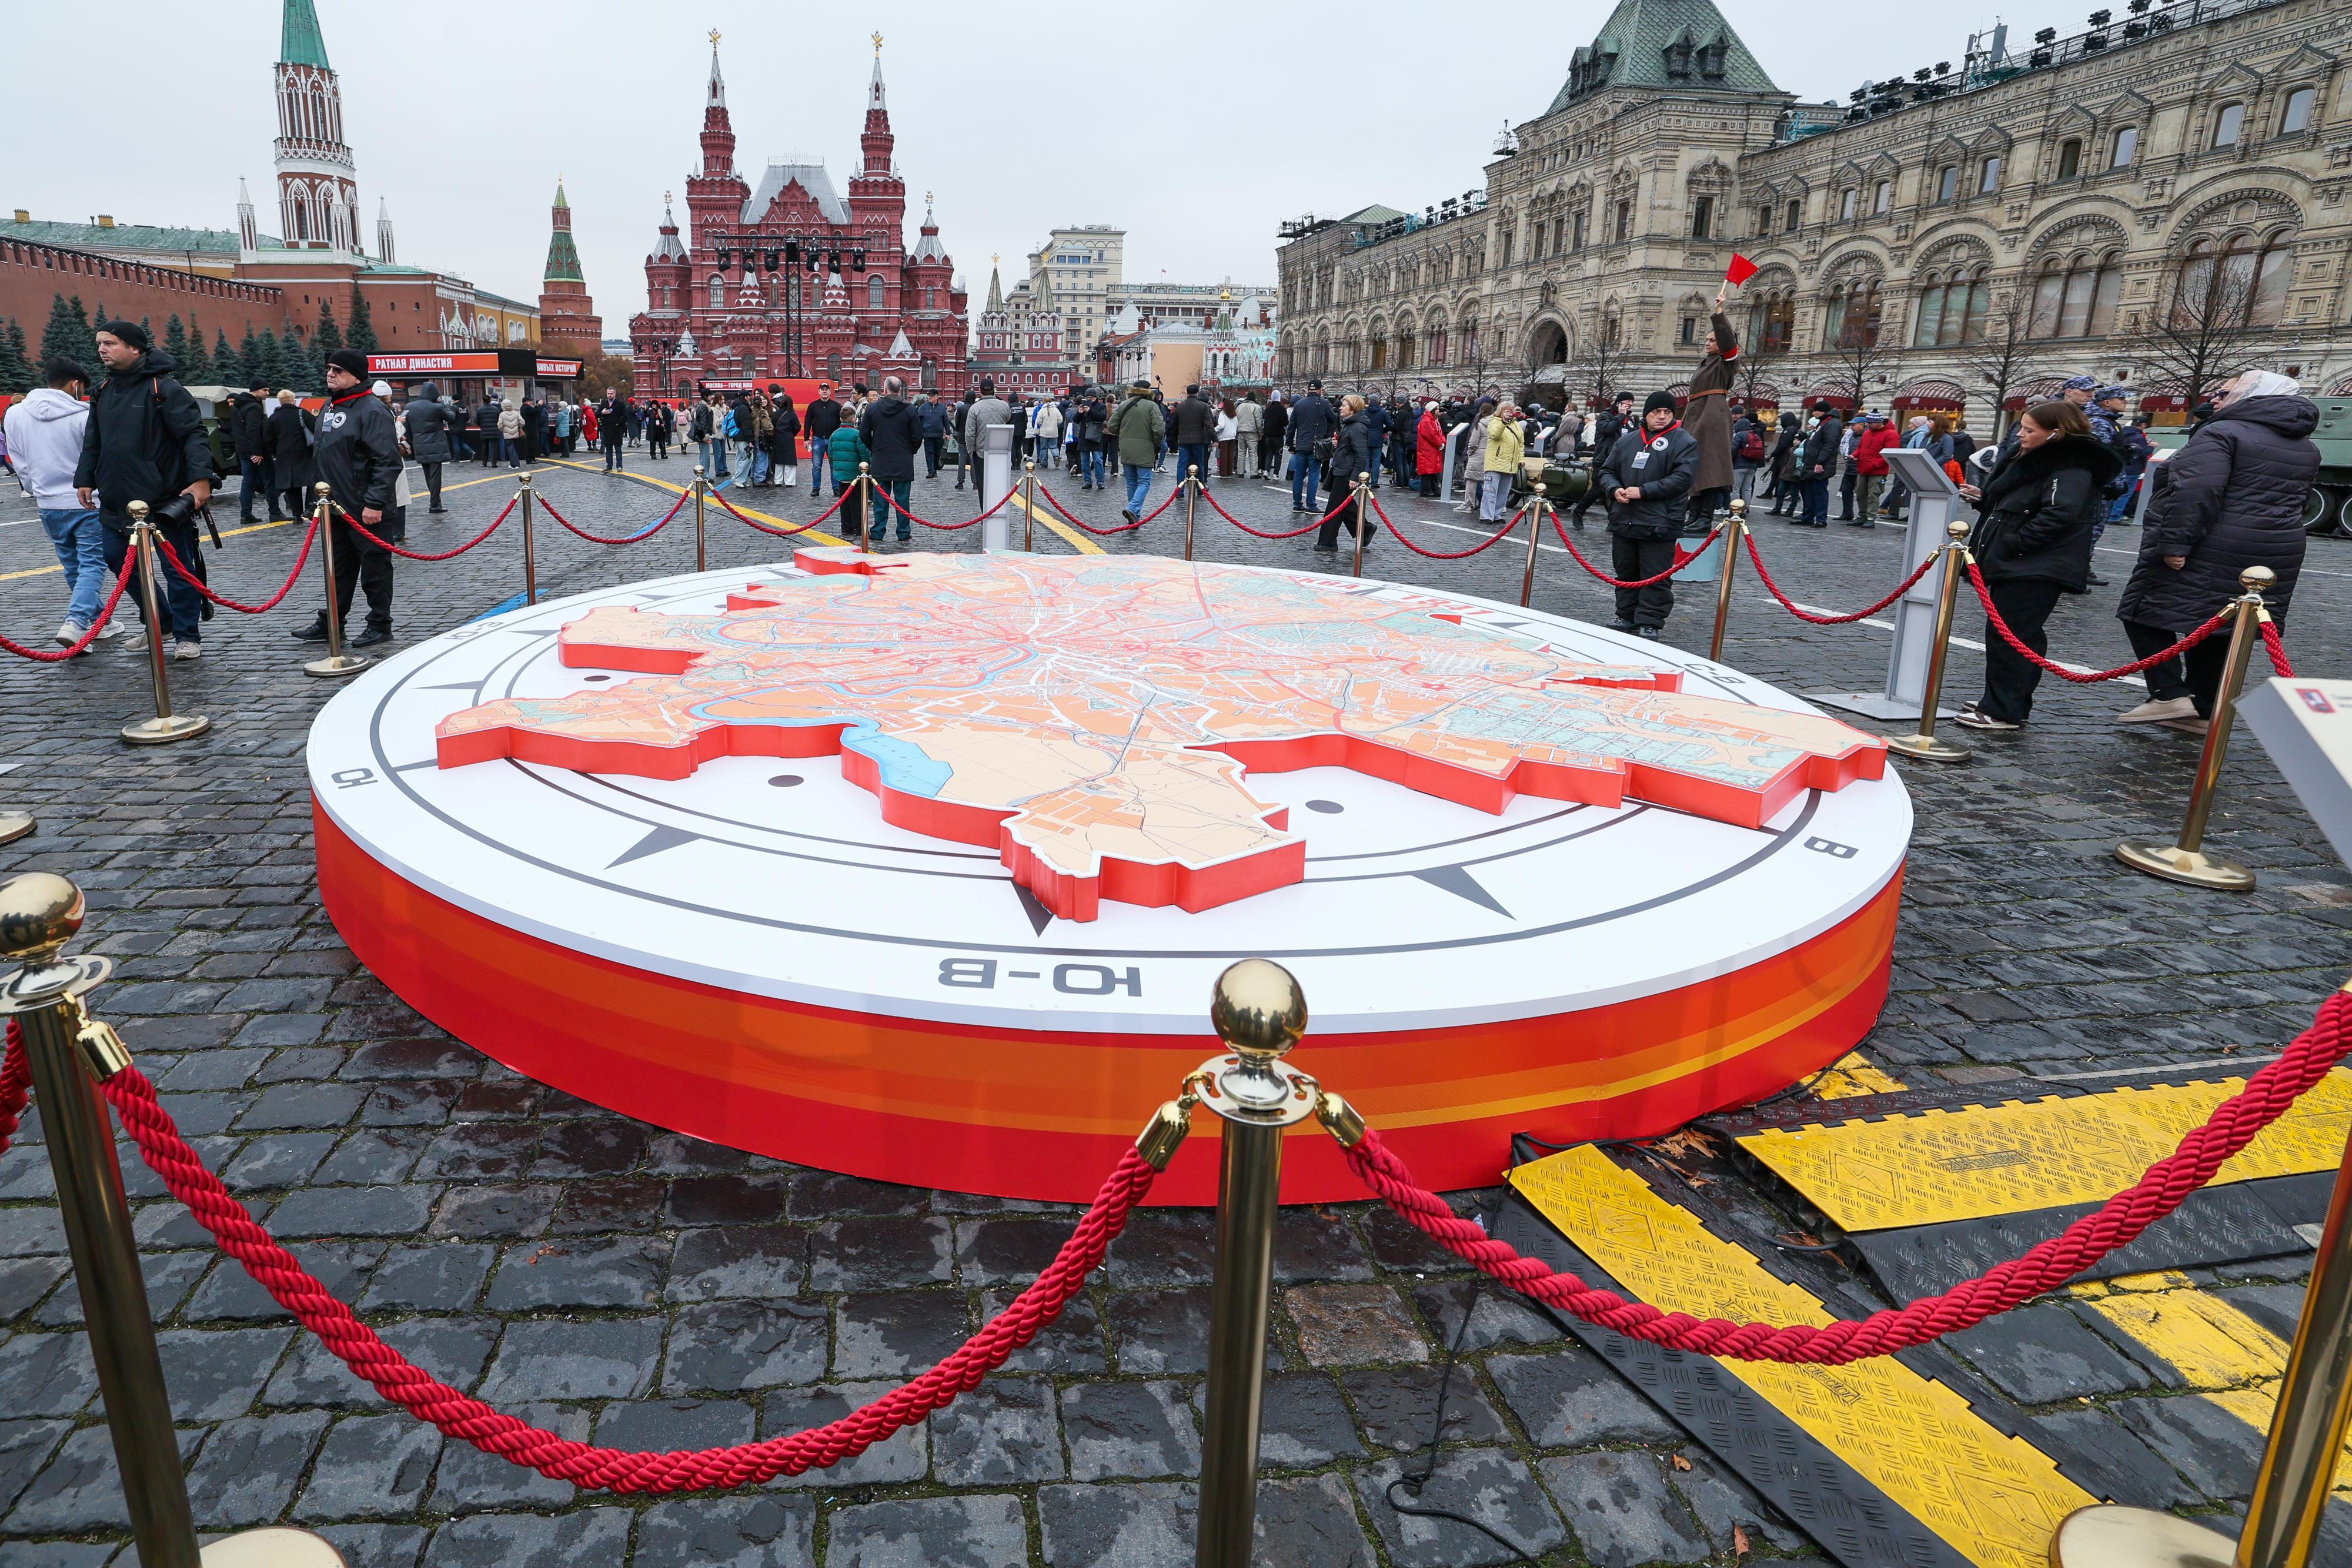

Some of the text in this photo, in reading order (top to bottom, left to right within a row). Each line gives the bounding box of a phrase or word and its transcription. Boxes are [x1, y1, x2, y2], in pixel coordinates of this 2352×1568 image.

[375, 357, 453, 370] РАТНАЯ ДИНАСТИЯ
[555, 363, 576, 373] ИСТОРИЙ
[1294, 577, 1361, 590] КВА
[1400, 594, 1496, 615] 1941
[442, 621, 505, 640] Ю-З
[1683, 663, 1747, 684] С-В
[331, 768, 379, 790] Ю
[1803, 835, 1859, 859] В
[937, 958, 1142, 998] Ю-В
[1805, 1363, 1858, 1398] otector
